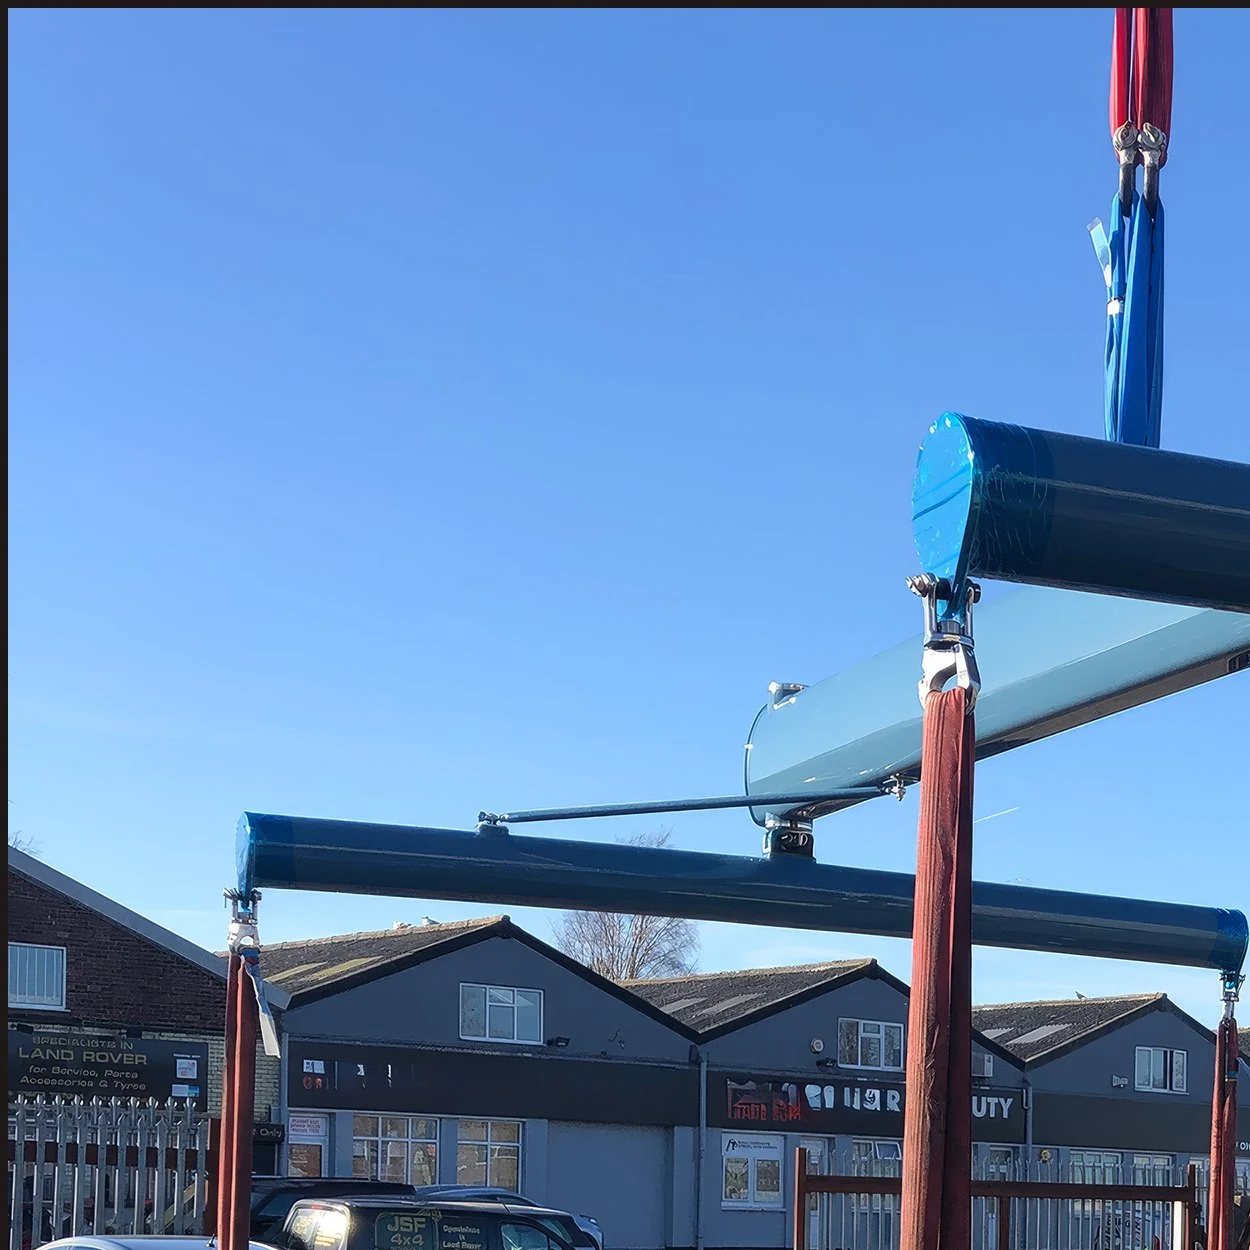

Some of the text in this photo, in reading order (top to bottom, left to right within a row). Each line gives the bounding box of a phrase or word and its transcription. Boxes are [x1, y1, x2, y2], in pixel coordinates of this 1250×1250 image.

[120, 1042, 134, 1050] IN
[18, 1047, 147, 1065] LAND ROVER
[29, 1065, 47, 1073] for
[114, 1081, 146, 1091] Tyres
[972, 1096, 1013, 1119] UTY
[387, 1216, 426, 1233] JSF
